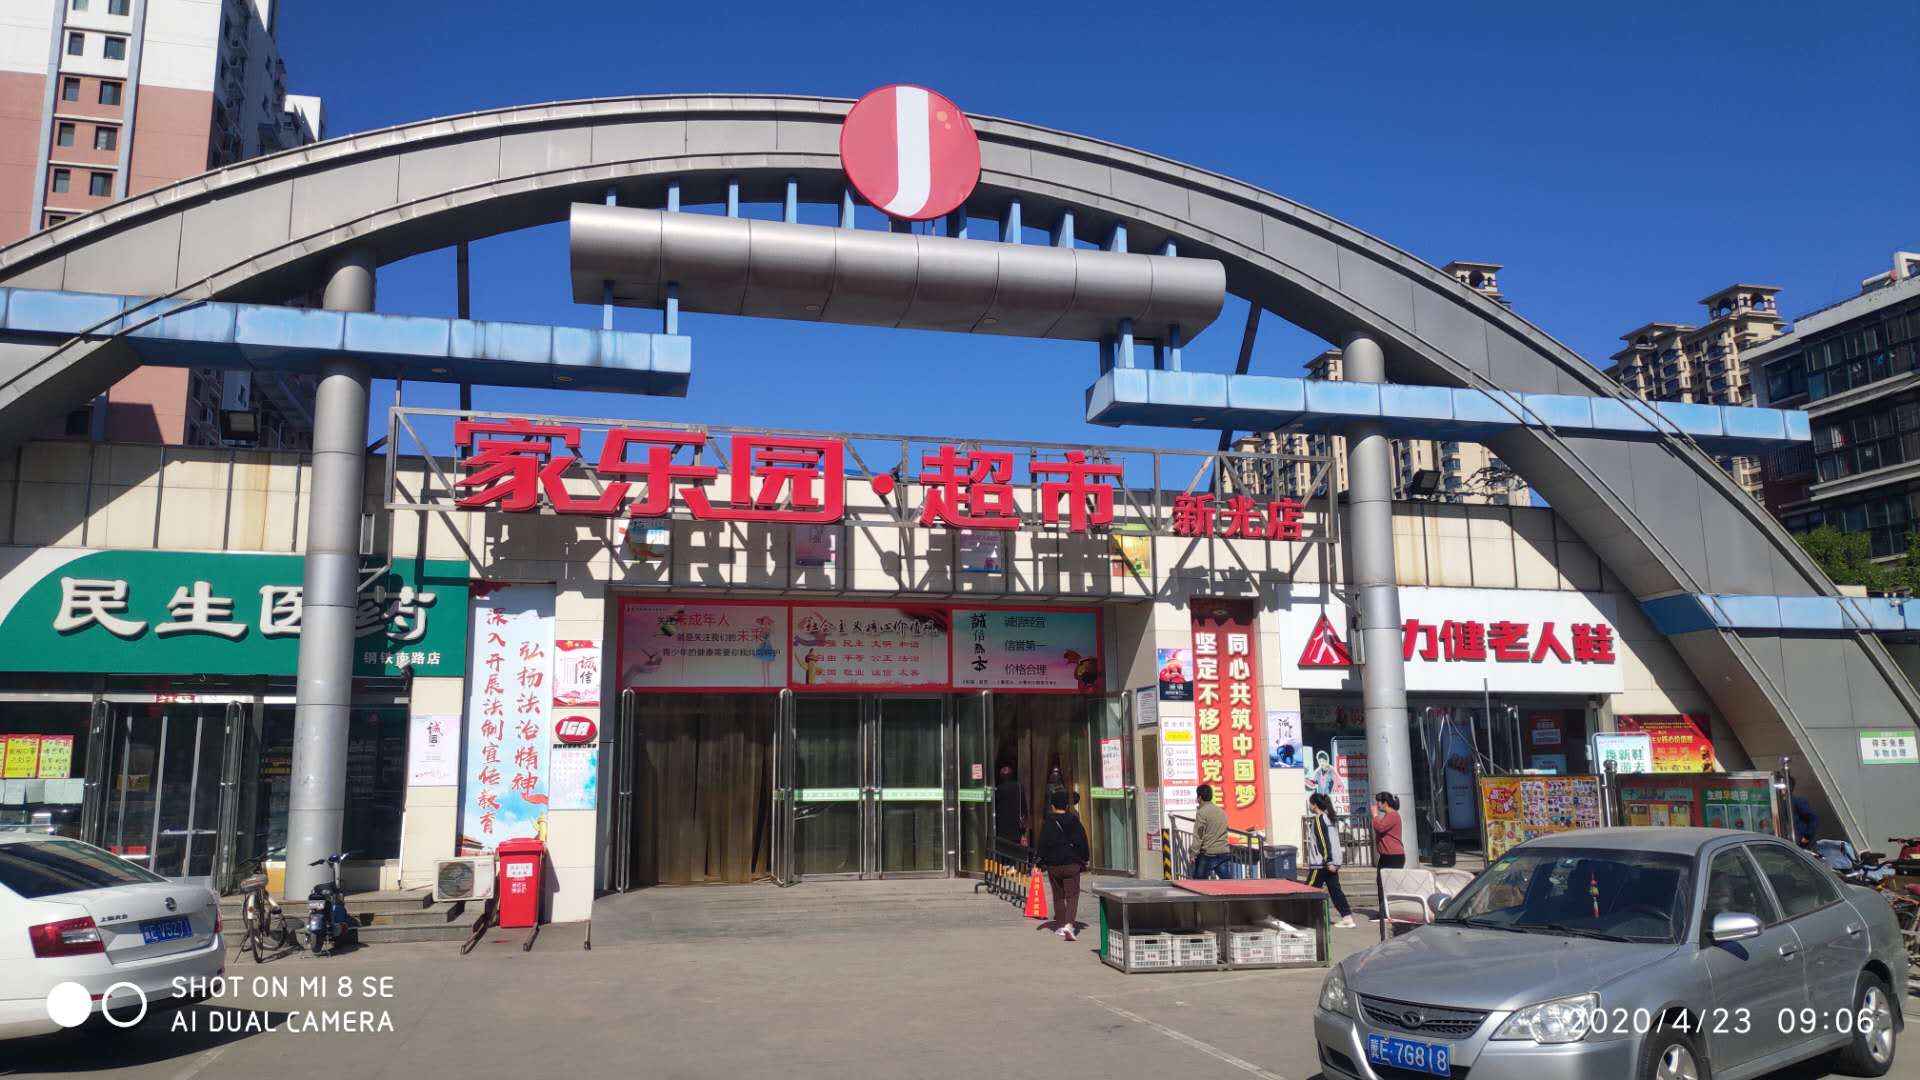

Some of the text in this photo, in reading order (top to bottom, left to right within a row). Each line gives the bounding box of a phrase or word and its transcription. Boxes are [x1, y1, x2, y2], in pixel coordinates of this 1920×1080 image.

[478, 607, 508, 835] 深入开展法制宣传教育
[511, 640, 545, 798] 弘扬法治精神
[1004, 663, 1049, 676] 价格合理
[1227, 632, 1257, 809] 同心共筑中国梦
